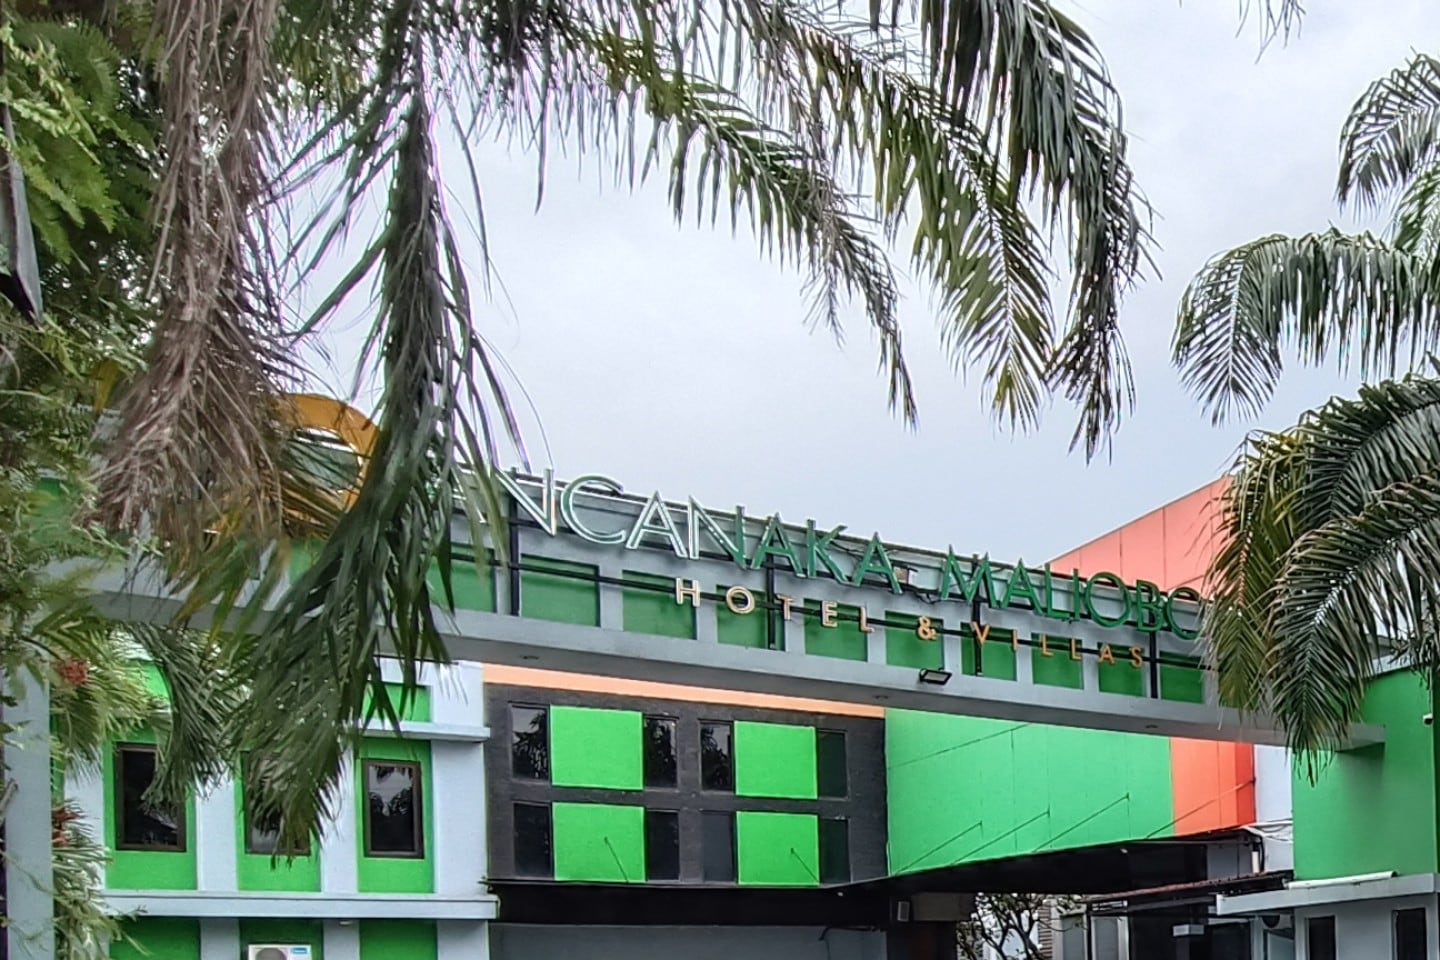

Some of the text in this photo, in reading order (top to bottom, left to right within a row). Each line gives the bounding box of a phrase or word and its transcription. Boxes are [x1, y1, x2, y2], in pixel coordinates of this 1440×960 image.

[456, 466, 903, 594] NCANAKA
[675, 577, 1144, 669] HOTEL & VILLAS
